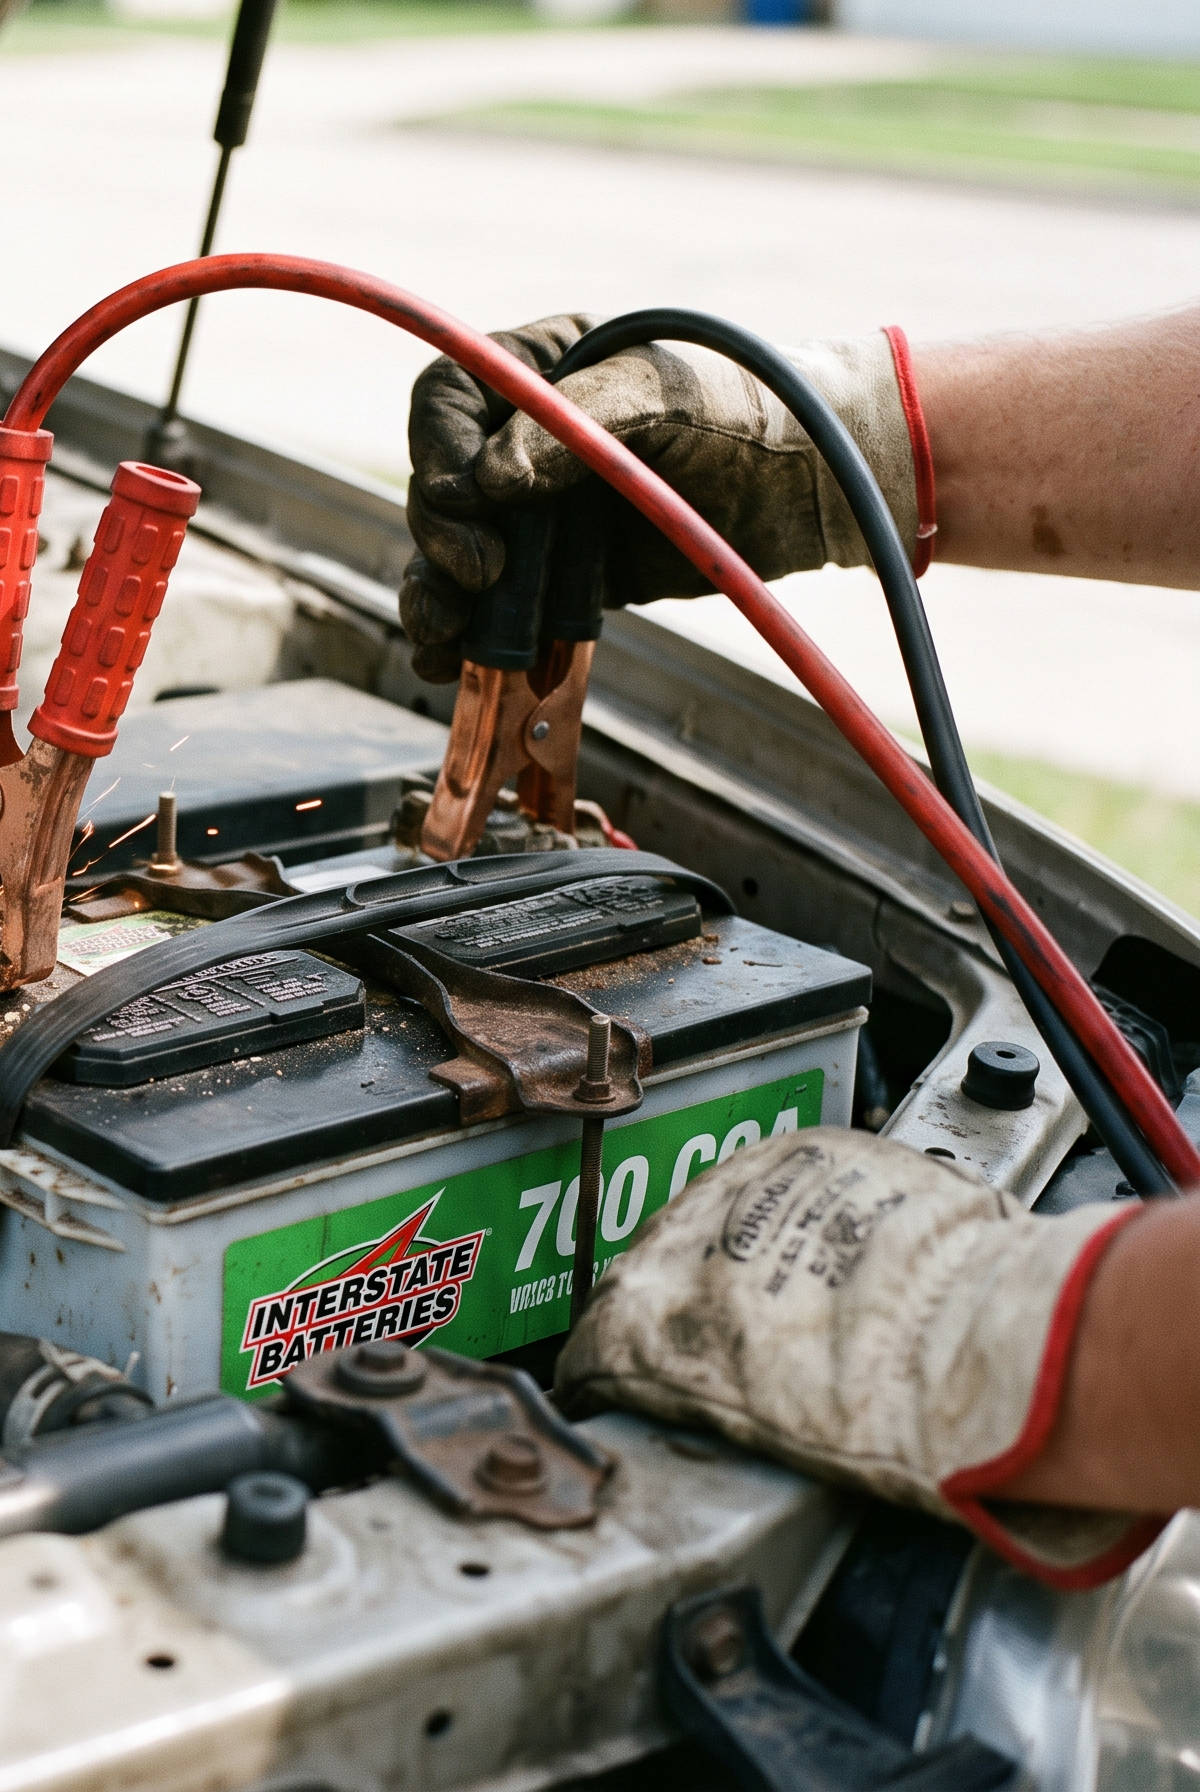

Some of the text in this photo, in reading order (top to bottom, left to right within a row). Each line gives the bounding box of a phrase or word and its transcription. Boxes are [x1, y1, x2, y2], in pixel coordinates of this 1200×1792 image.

[514, 1155, 650, 1273] 700
[250, 1239, 478, 1341] INTERSTATE
[256, 1283, 458, 1378] BATTERIES
